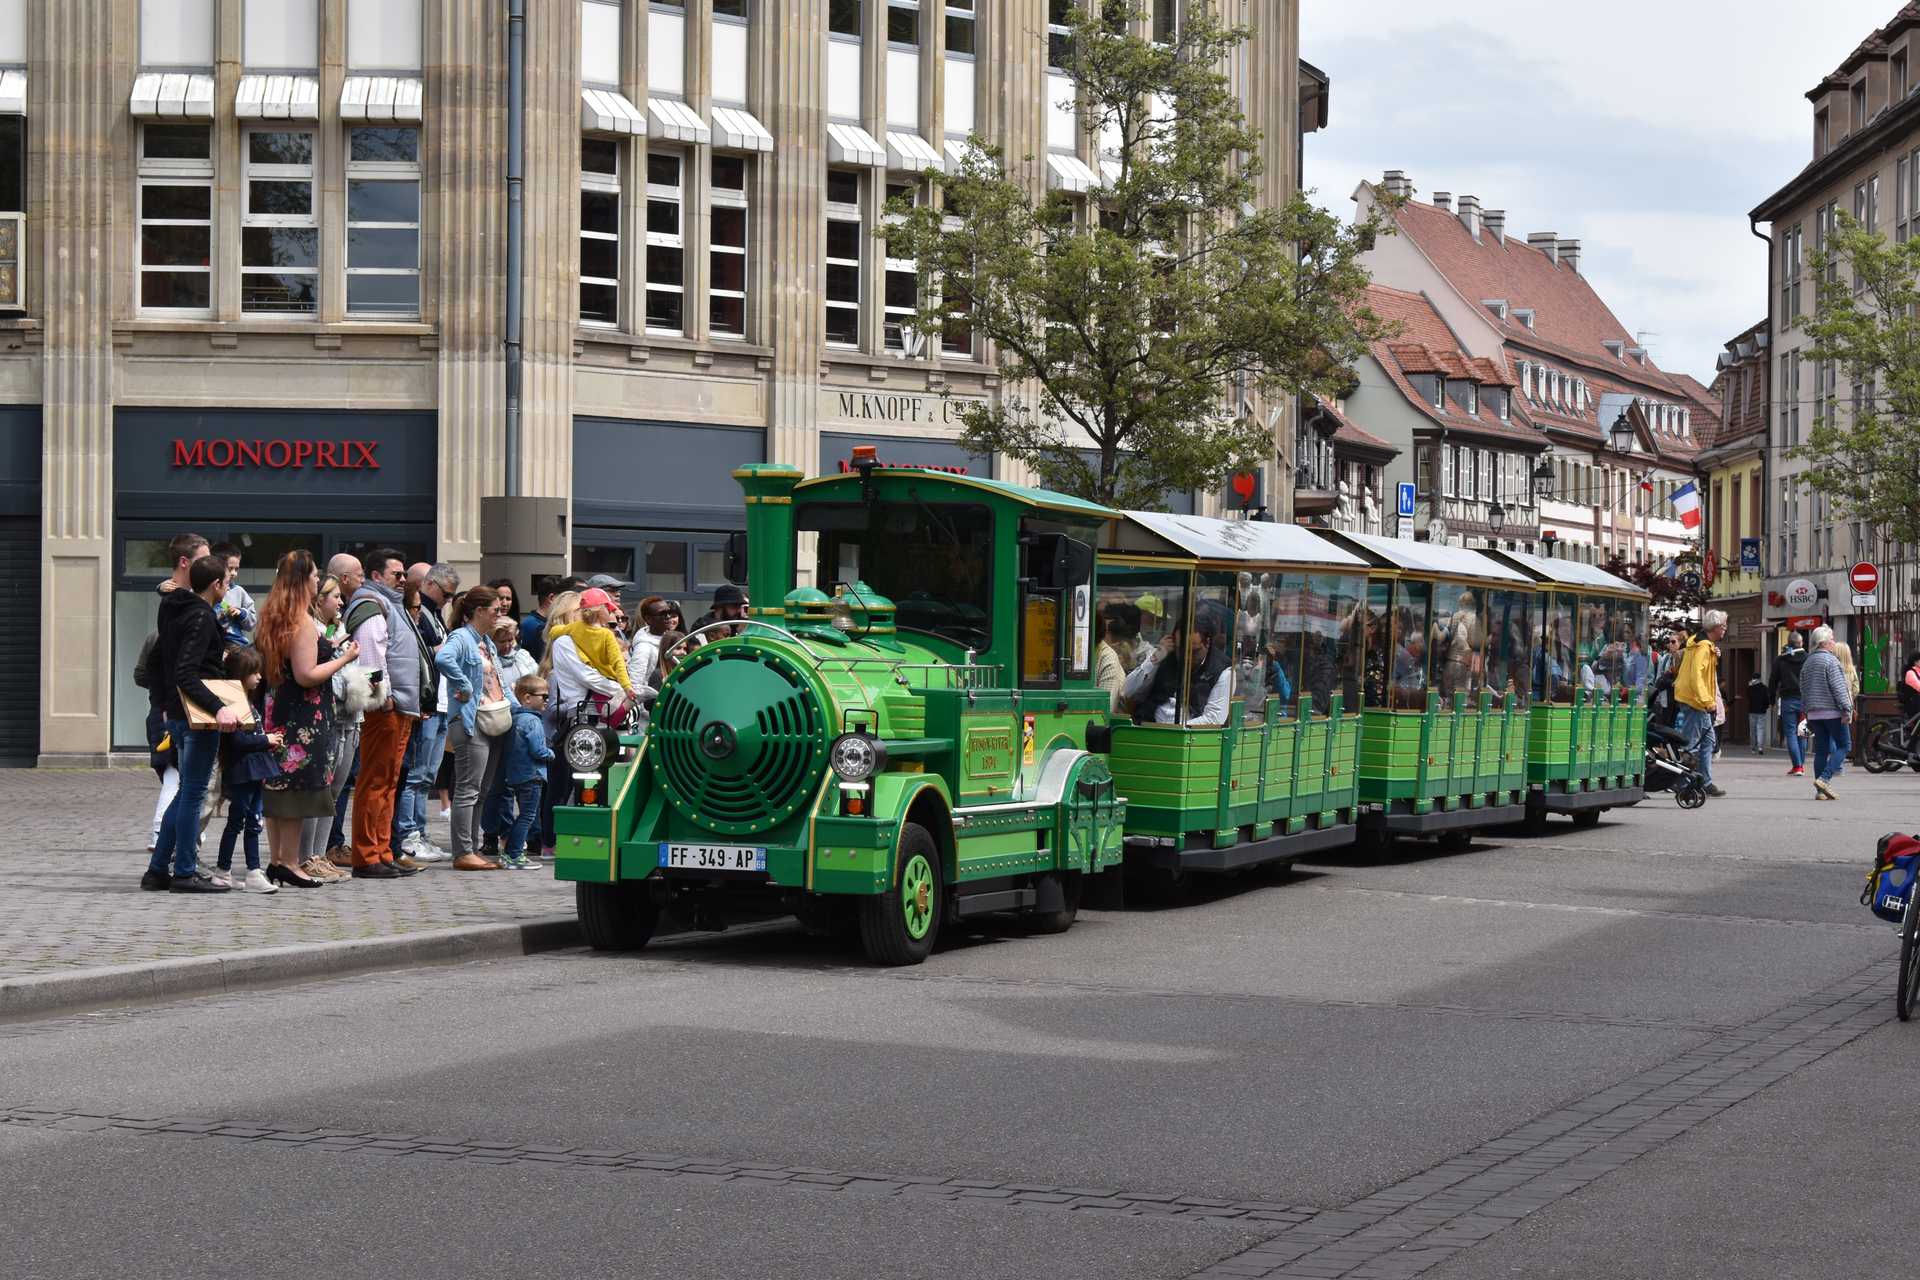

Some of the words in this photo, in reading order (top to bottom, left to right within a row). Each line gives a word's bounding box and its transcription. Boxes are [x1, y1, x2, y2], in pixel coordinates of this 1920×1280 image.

[839, 392, 922, 422] M.KNOPF
[172, 439, 380, 468] MONOPRIX
[1790, 595, 1814, 604] HSBC
